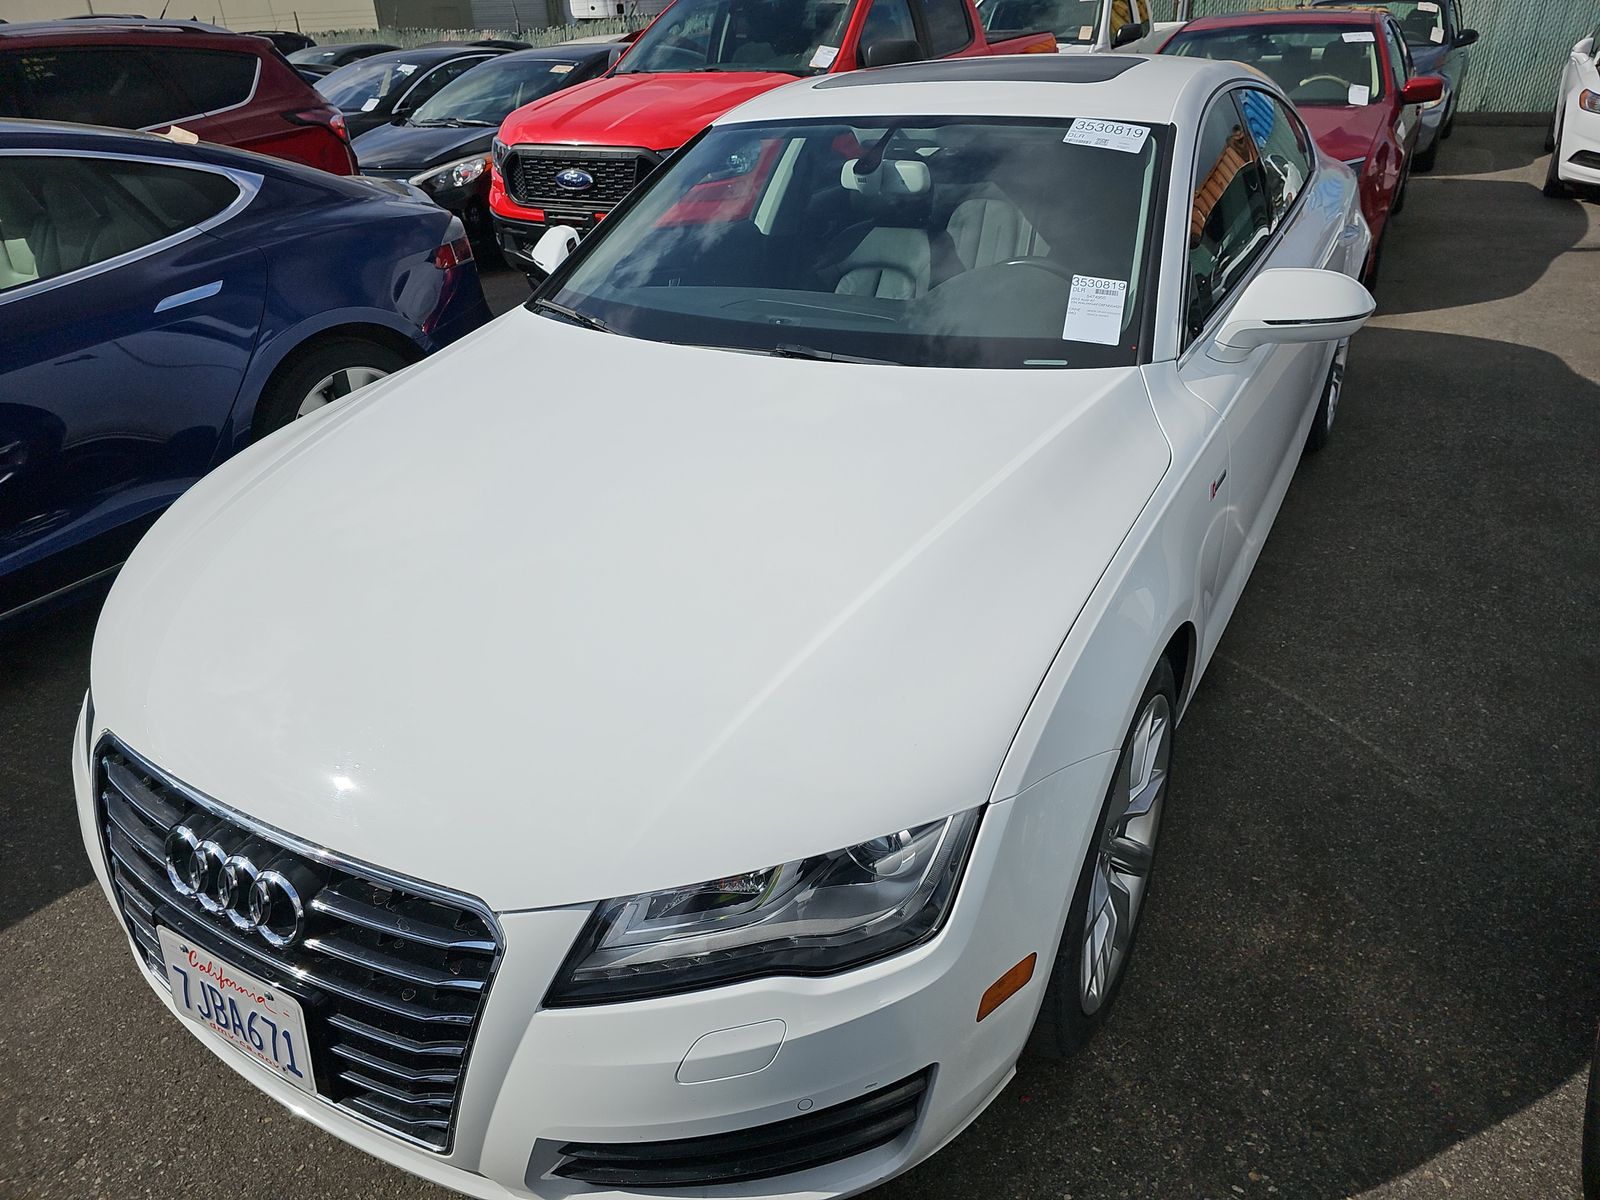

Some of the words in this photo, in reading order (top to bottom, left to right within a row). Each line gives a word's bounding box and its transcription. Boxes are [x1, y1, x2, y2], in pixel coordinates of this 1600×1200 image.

[1075, 120, 1144, 139] 3530819
[1072, 276, 1126, 291] 3530819
[188, 949, 277, 1015] California
[172, 964, 303, 1079] 7JBA671
